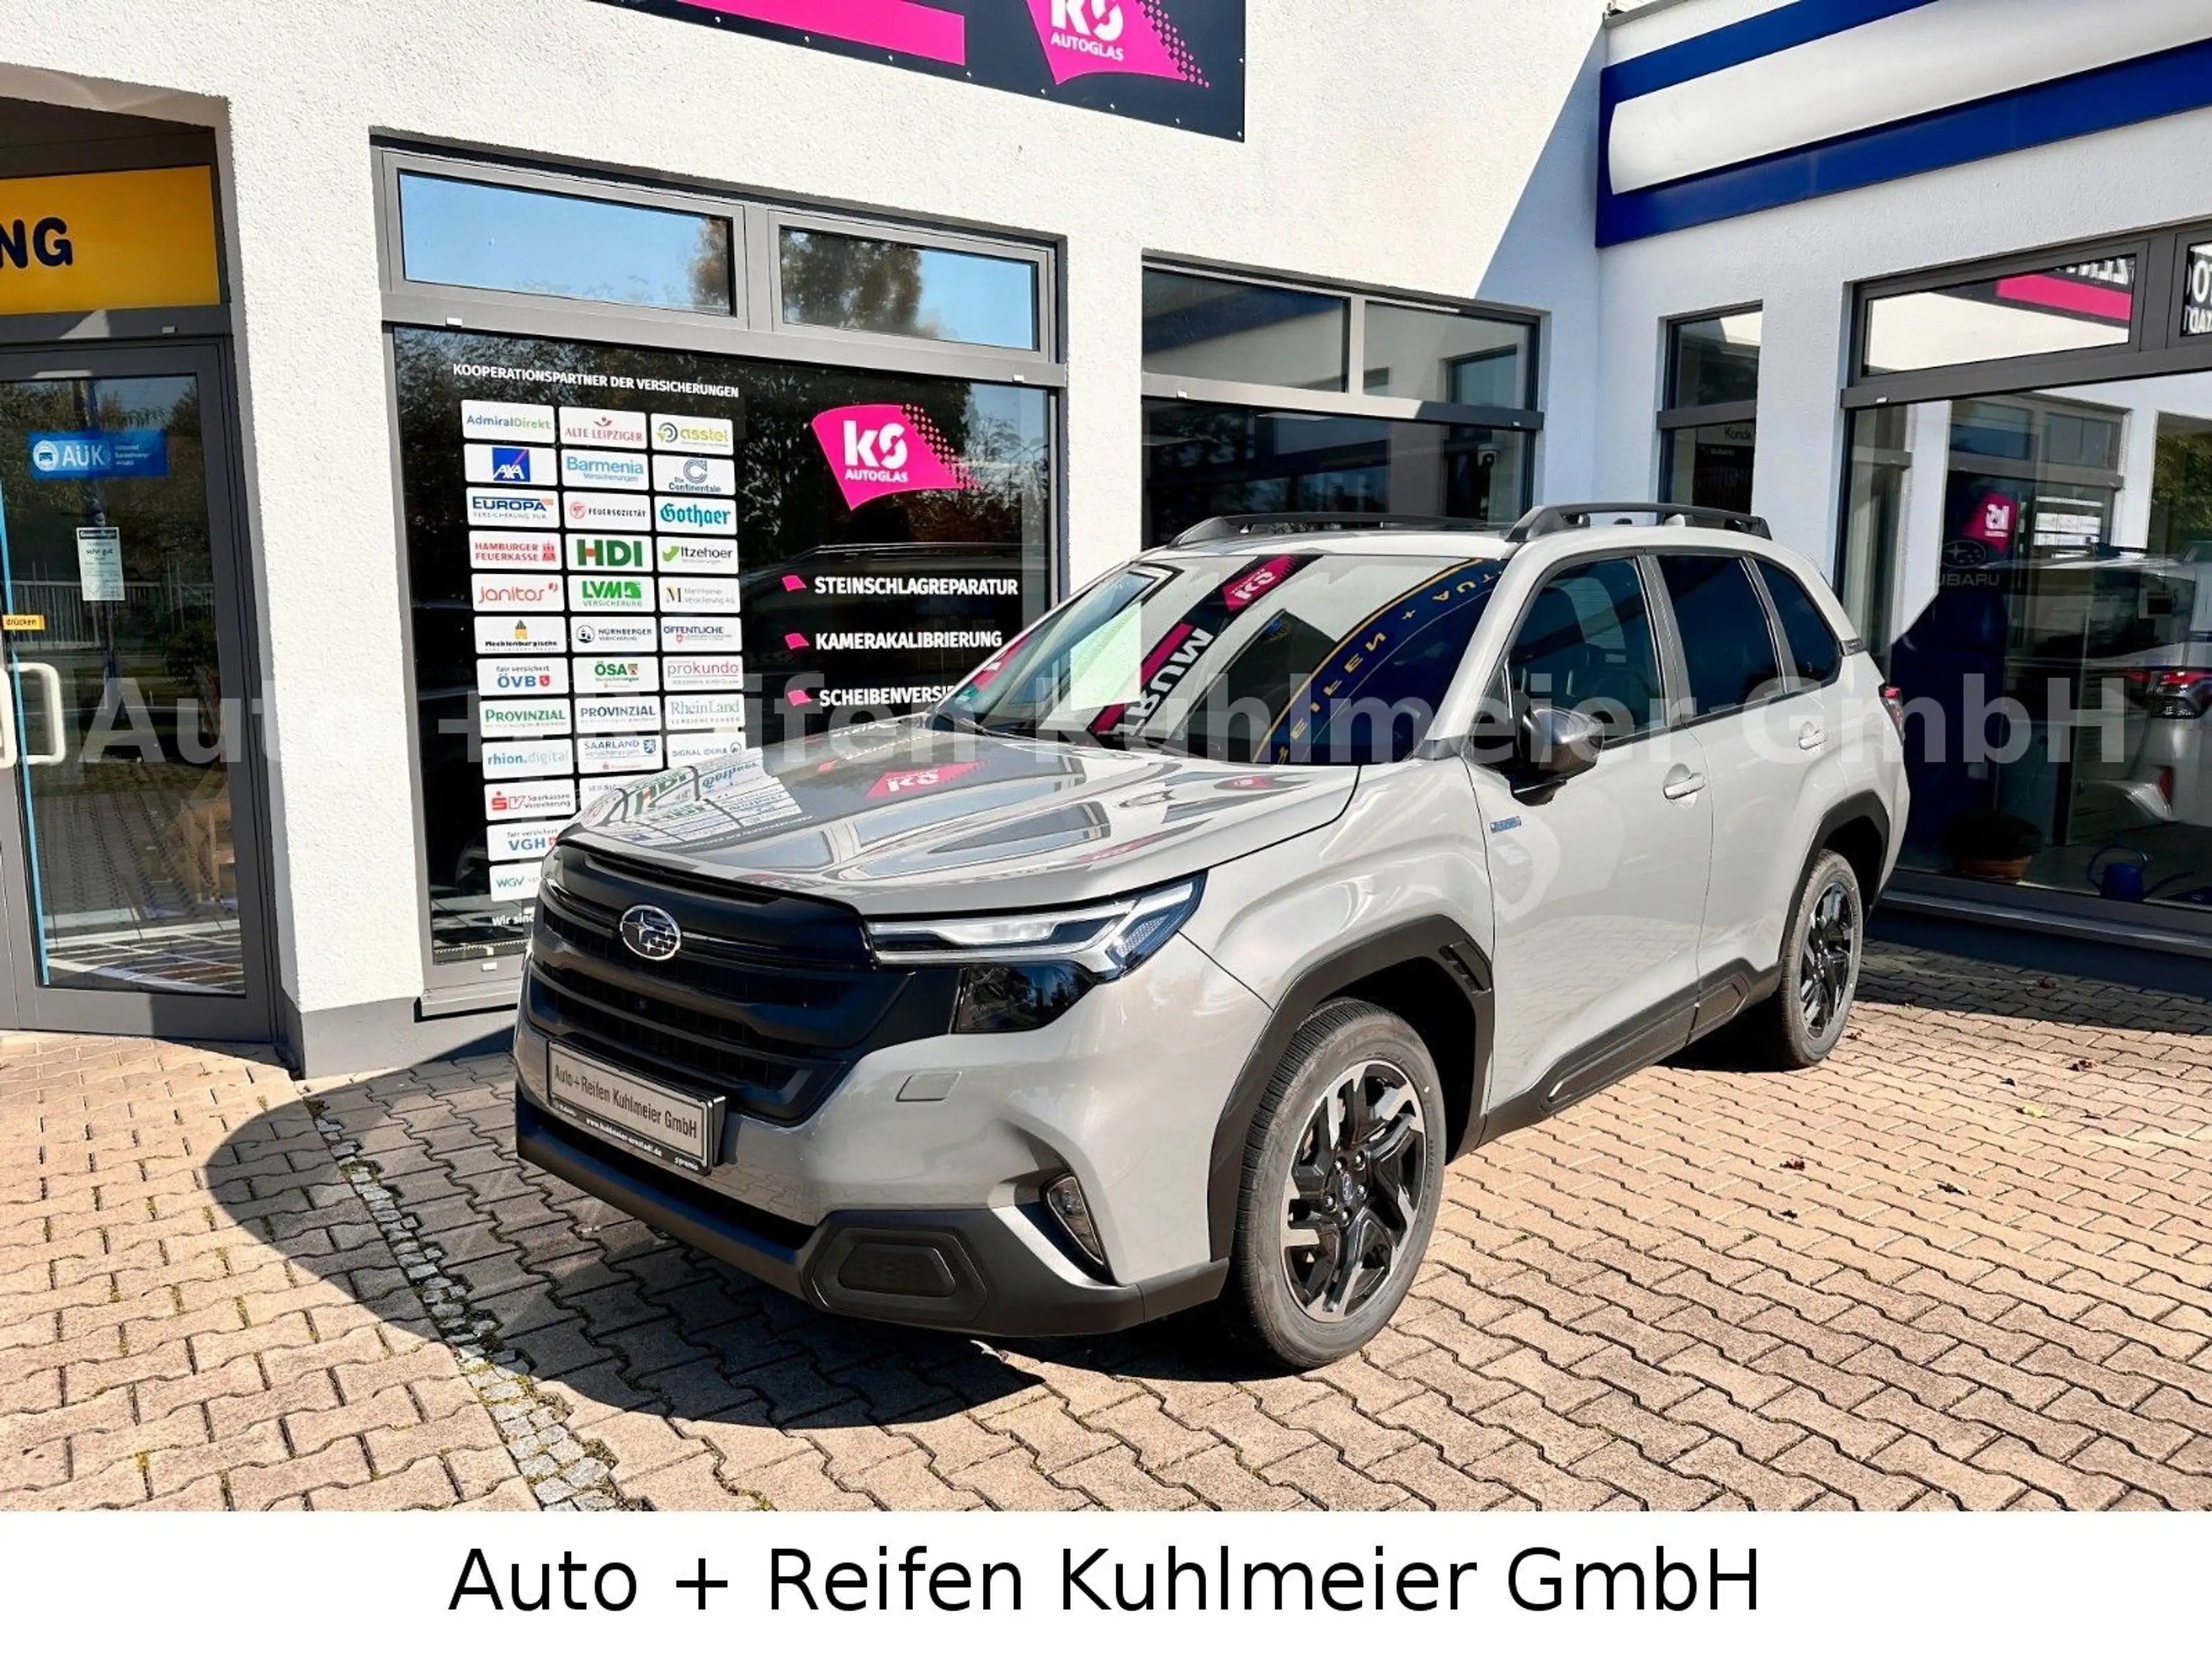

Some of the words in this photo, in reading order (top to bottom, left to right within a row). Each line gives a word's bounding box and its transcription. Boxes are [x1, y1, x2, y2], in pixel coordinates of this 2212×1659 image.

[1050, 32, 1124, 62] AUTOGLAS
[453, 363, 607, 387] KOOPERATIONSPARTNER
[610, 377, 634, 389] DER
[637, 379, 740, 398] VERSICHERUNGEN
[467, 415, 551, 430] AdmiralDirekt
[565, 428, 589, 440] ALTE
[592, 429, 642, 442] LEIPZIGER
[680, 427, 728, 442] asstel
[62, 444, 105, 467] AÜK
[493, 464, 525, 481] AXA
[566, 456, 643, 474] Barmenia
[584, 472, 638, 482] Versicherungen
[844, 468, 908, 483] AUTOGLAS
[669, 482, 721, 492] Continentale
[472, 496, 547, 512] EUROPA
[588, 507, 646, 518] FEUERSOZIETÄT
[660, 502, 732, 527] Gothaer
[475, 542, 539, 552] HAMBURGER
[577, 539, 643, 567] HDI
[681, 546, 733, 558] Itzehoer
[475, 552, 539, 562] FEUERKASSE
[582, 581, 622, 599] LVM
[815, 576, 1018, 595] STEINSCHLAGREPARATUR
[583, 599, 643, 607] VERSICHERUNG
[5, 616, 37, 626] drücken
[816, 630, 1002, 650] KAMERAKALIBRIERUNG
[594, 661, 627, 676] ÖSA
[668, 661, 739, 679] prokundo
[498, 673, 536, 688] ÖVB
[819, 685, 954, 706] SCHEIBENVERSI
[581, 705, 657, 718] PROVINZIAL
[671, 699, 739, 715] RheinLand
[485, 709, 566, 722] PROVINZIAL
[584, 739, 639, 750] SAARLAND
[487, 751, 569, 767] rhion.digital
[528, 793, 570, 802] Sparkassen
[509, 837, 546, 851] VGH
[496, 877, 525, 888] WGV
[555, 1064, 573, 1087] Auto
[581, 1075, 611, 1103] Reifen
[613, 1088, 662, 1124] Kuhlmeier
[665, 1109, 698, 1139] GmbH
